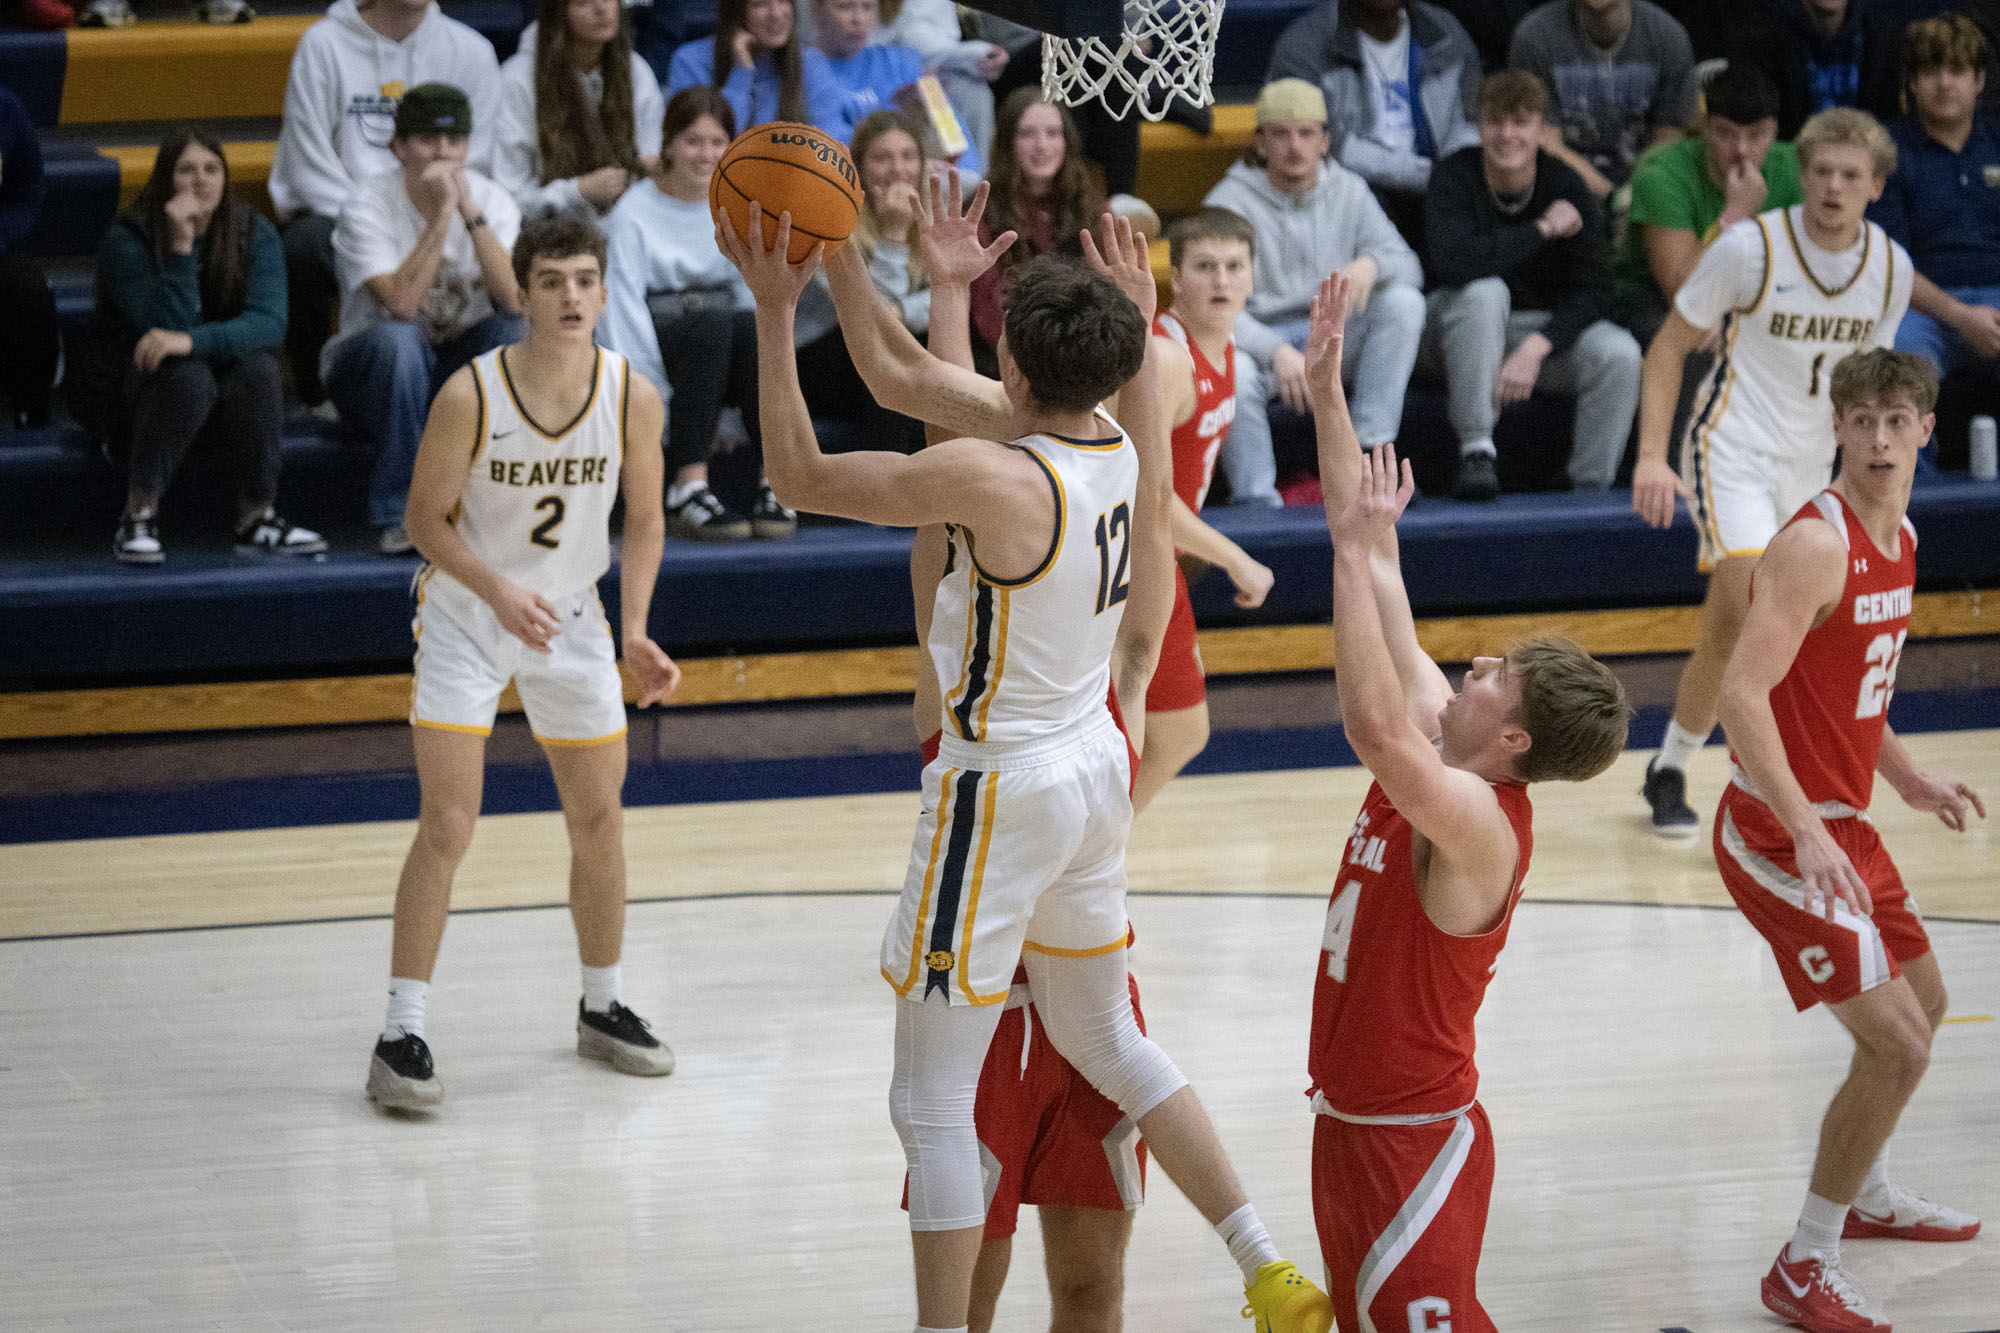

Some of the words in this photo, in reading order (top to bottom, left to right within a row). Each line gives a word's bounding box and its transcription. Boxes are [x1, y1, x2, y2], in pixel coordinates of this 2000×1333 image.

[771, 133, 857, 191] Wilson
[1808, 352, 1825, 396] 1
[529, 495, 565, 549] 2
[1094, 499, 1130, 617] 12
[1798, 945, 1836, 984] C
[1406, 1295, 1453, 1333] C
